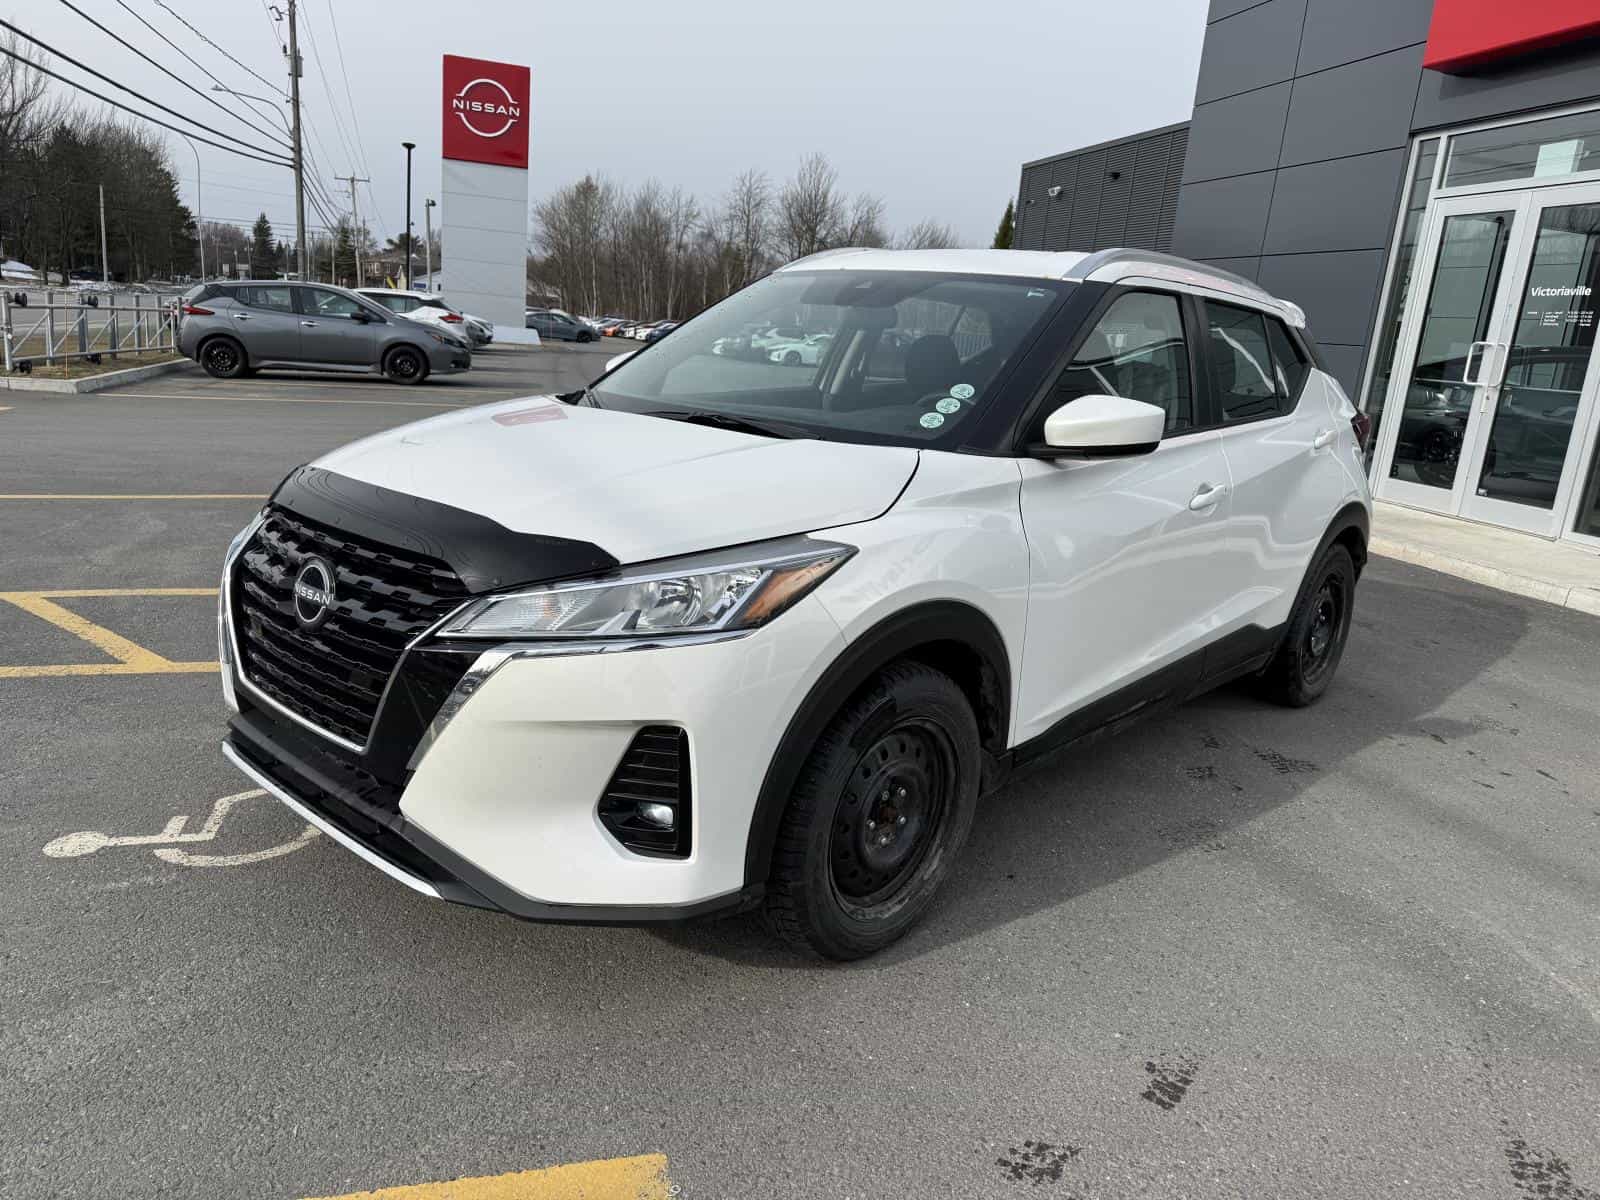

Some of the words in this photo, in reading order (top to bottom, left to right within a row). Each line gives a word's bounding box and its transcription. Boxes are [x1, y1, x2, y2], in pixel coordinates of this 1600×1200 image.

[453, 98, 520, 117] NISSAN
[1531, 285, 1592, 297] Victoriaville
[294, 583, 331, 605] NISSAN
